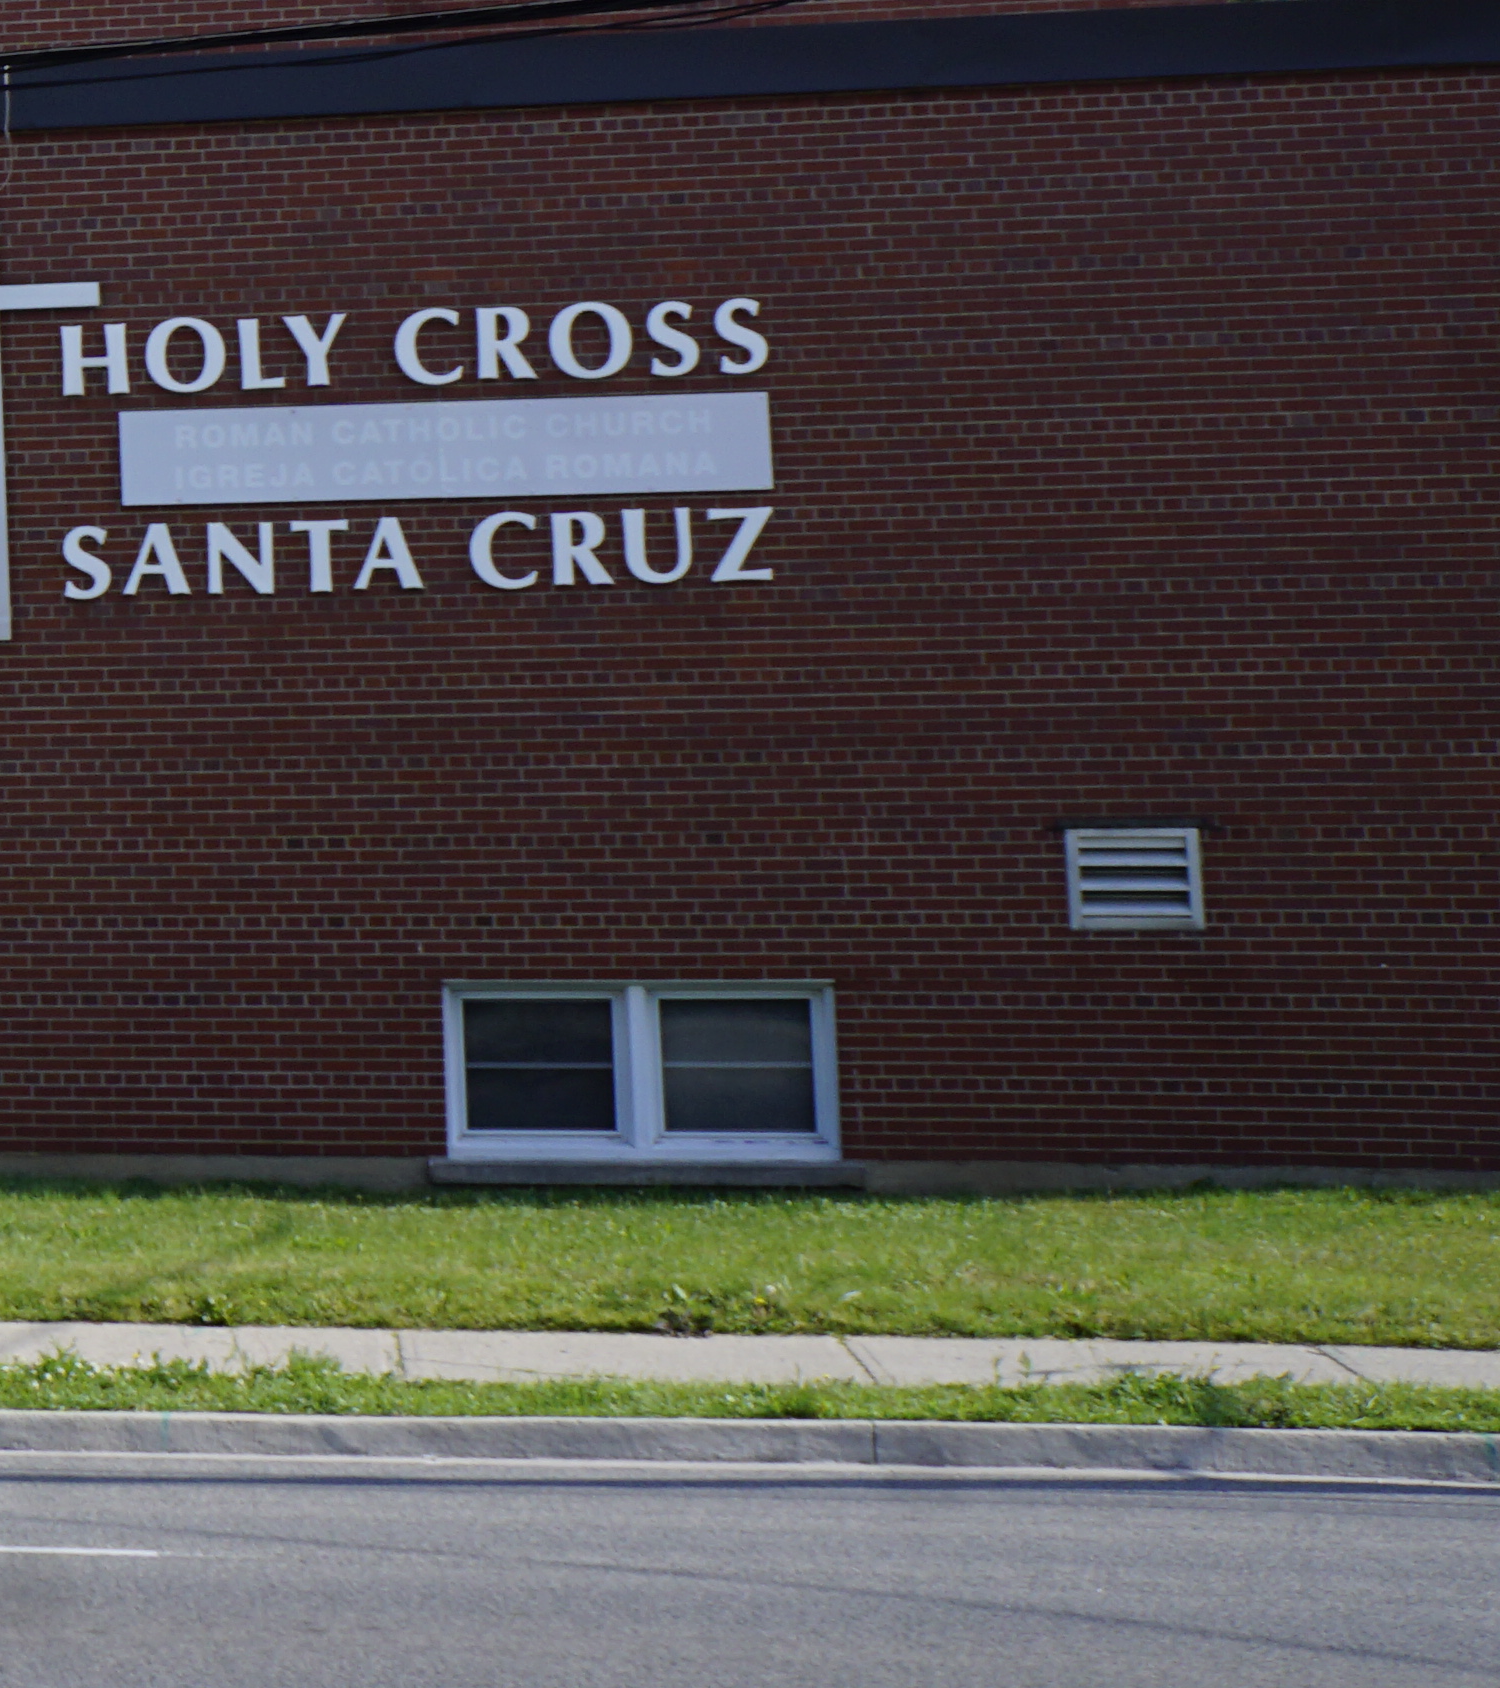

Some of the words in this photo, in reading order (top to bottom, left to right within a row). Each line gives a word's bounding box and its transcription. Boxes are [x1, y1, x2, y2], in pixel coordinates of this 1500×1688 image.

[60, 313, 347, 396] HOLY
[394, 297, 769, 385] CROSS
[175, 421, 314, 449] ROMAN
[331, 414, 527, 445] CATHOLIC
[545, 408, 712, 438] CHURCH
[175, 463, 316, 490] IGREJA
[545, 450, 718, 480] ROMANA
[62, 516, 424, 600] SANTA
[469, 506, 774, 589] CRUZ
